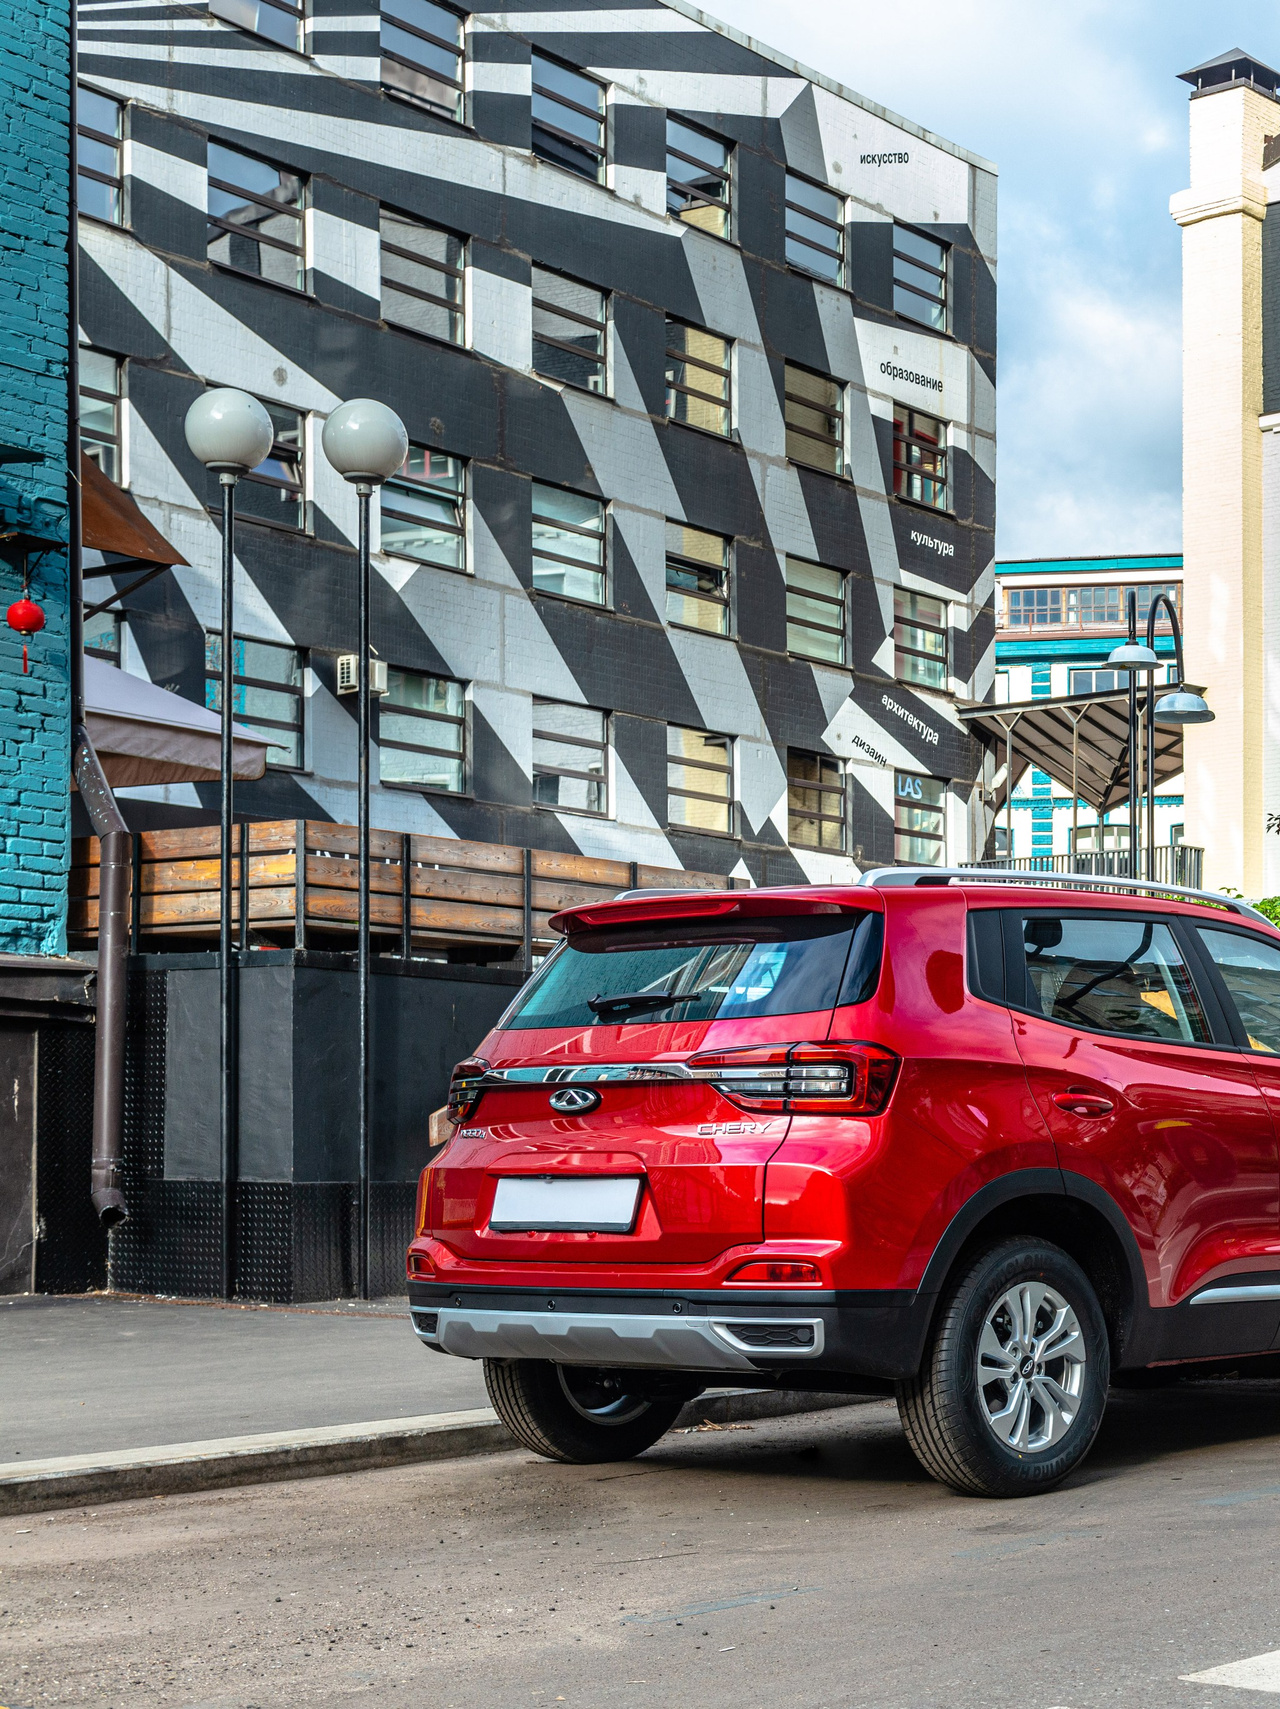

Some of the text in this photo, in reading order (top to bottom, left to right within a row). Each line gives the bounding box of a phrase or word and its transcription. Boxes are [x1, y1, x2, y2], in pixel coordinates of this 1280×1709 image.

[860, 152, 909, 167] искусство
[880, 361, 944, 393] образование
[910, 530, 955, 557] культура
[881, 694, 939, 746] архитектура
[898, 774, 923, 800] LAS
[697, 1122, 772, 1135] CHERY
